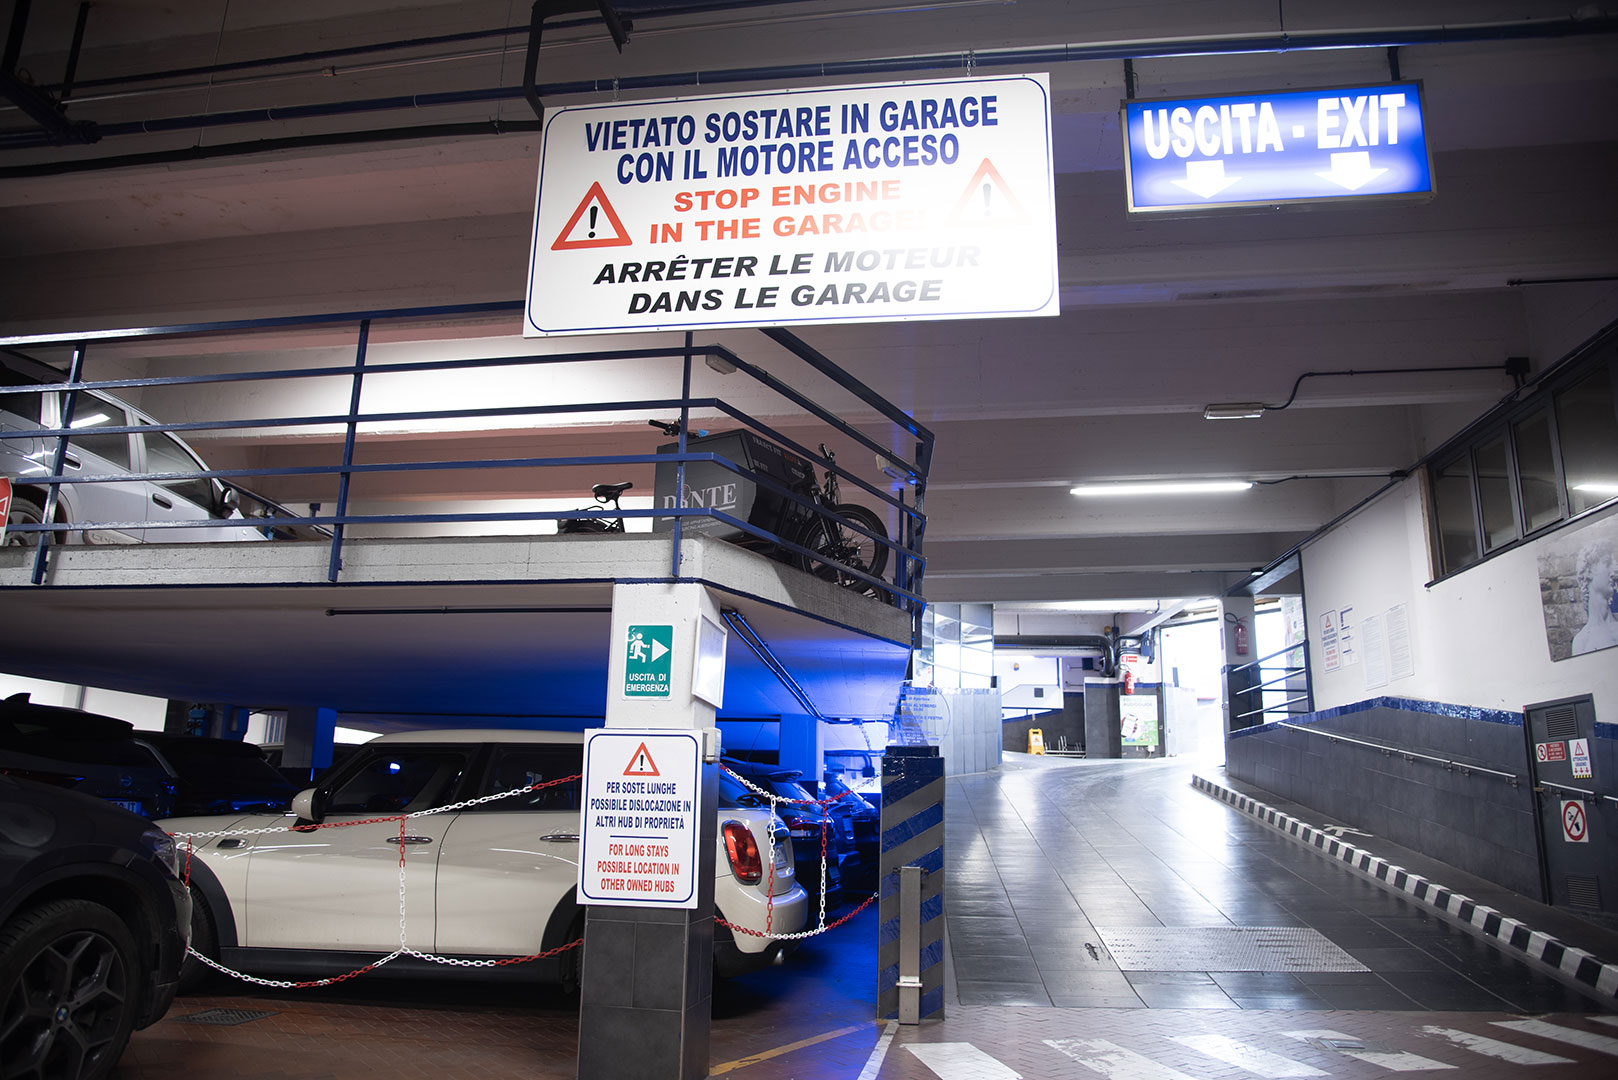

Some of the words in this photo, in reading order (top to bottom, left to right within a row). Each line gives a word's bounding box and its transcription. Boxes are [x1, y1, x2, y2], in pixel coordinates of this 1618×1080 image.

[586, 115, 695, 152] VIETATO
[705, 107, 830, 142] SOSTARE
[842, 103, 868, 134] IN
[880, 96, 998, 131] GARAGE
[1143, 102, 1284, 160] USCITA
[1317, 93, 1406, 149] EXIT
[617, 150, 673, 185] CON
[683, 149, 707, 180] IL
[718, 141, 833, 177] MOTORE
[844, 134, 959, 169] ACCESO
[674, 188, 759, 212] STOP
[772, 179, 901, 207] ENGINE
[650, 221, 683, 244] IN
[694, 218, 760, 241] THE
[593, 254, 758, 284] ARRÊTER
[769, 253, 813, 276] LE
[824, 245, 980, 273] MOTEUR
[628, 288, 722, 315] DANS
[734, 286, 780, 310] LE
[790, 279, 943, 308] GARAGE
[629, 672, 655, 681] USCITA
[658, 673, 666, 681] DI
[626, 684, 669, 692] EMERGENZA
[606, 782, 620, 794] PER
[622, 782, 645, 794] SOSTE
[647, 783, 676, 794] LUNGHE
[591, 798, 627, 810] POSSIBILE
[629, 800, 681, 812] DISLOCAZIONE
[683, 801, 691, 812] IN
[596, 816, 616, 827] ALTRI
[618, 816, 633, 828] HUB
[635, 817, 642, 828] DI
[644, 815, 684, 829] PROPRIETÀ
[609, 844, 624, 856] FOR
[625, 845, 644, 856] LONG
[646, 846, 669, 857] STAYS
[598, 861, 631, 873] POSSIBLE
[634, 862, 670, 875] LOCATION
[672, 864, 679, 875] IN
[600, 878, 625, 890] OTHER
[627, 879, 653, 891] OWNED
[655, 880, 675, 892] HUBS
